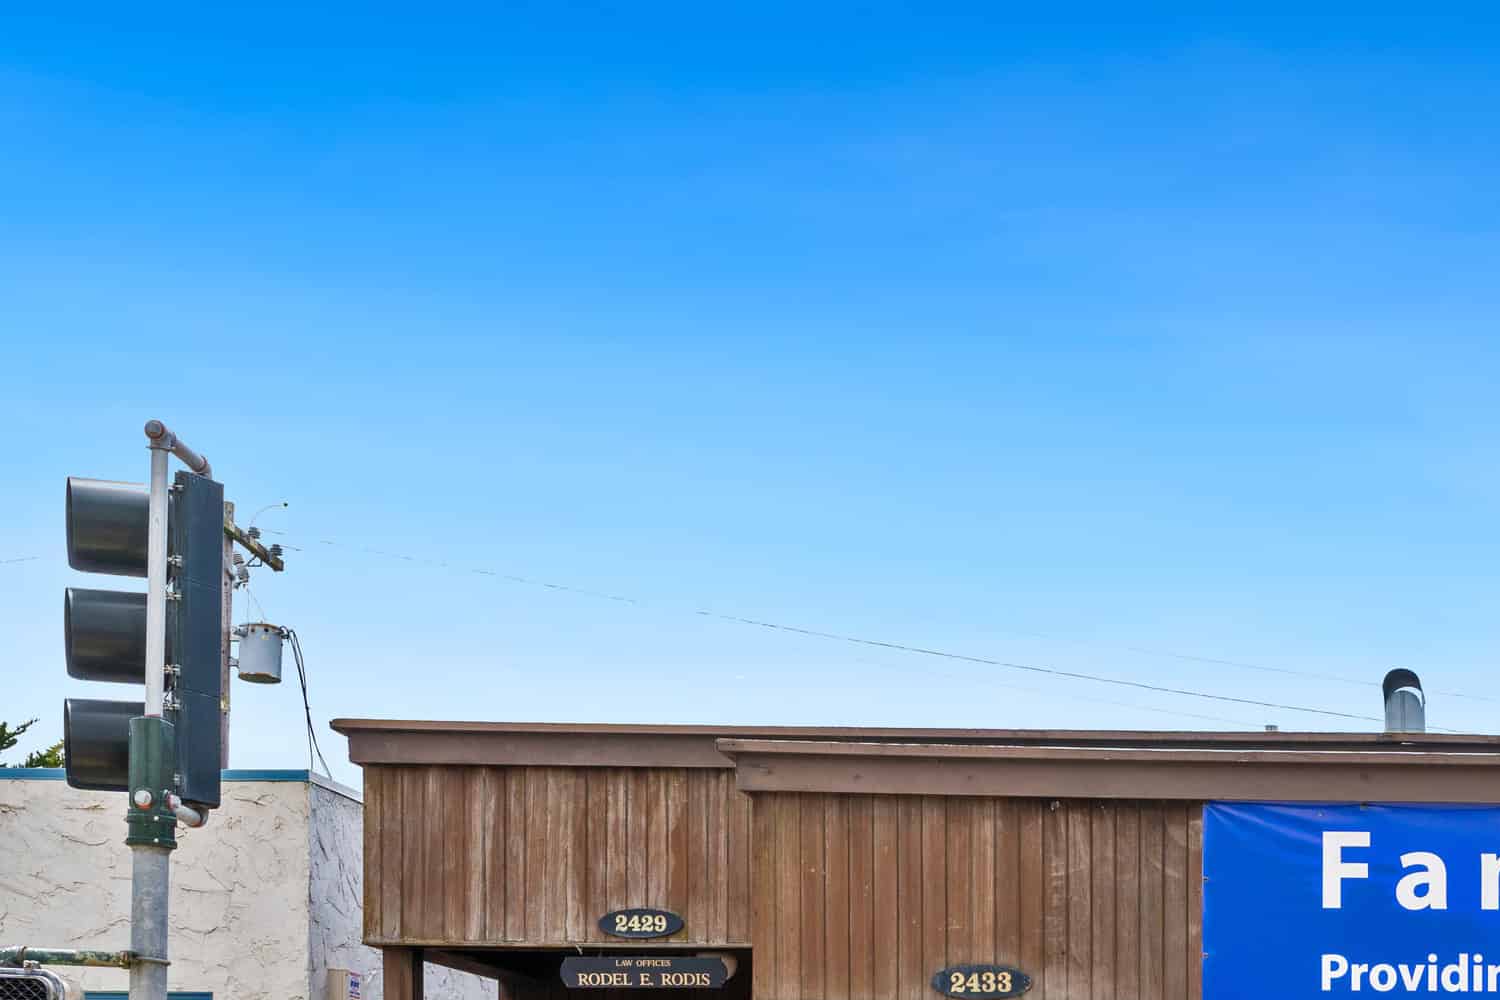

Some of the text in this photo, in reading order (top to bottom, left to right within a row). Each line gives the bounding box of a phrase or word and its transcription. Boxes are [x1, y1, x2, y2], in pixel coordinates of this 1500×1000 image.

[615, 914, 668, 932] 2429
[615, 959, 672, 967] LAW OFFICES
[577, 973, 711, 986] RODEL E. RODIS
[950, 972, 1012, 993] 2433
